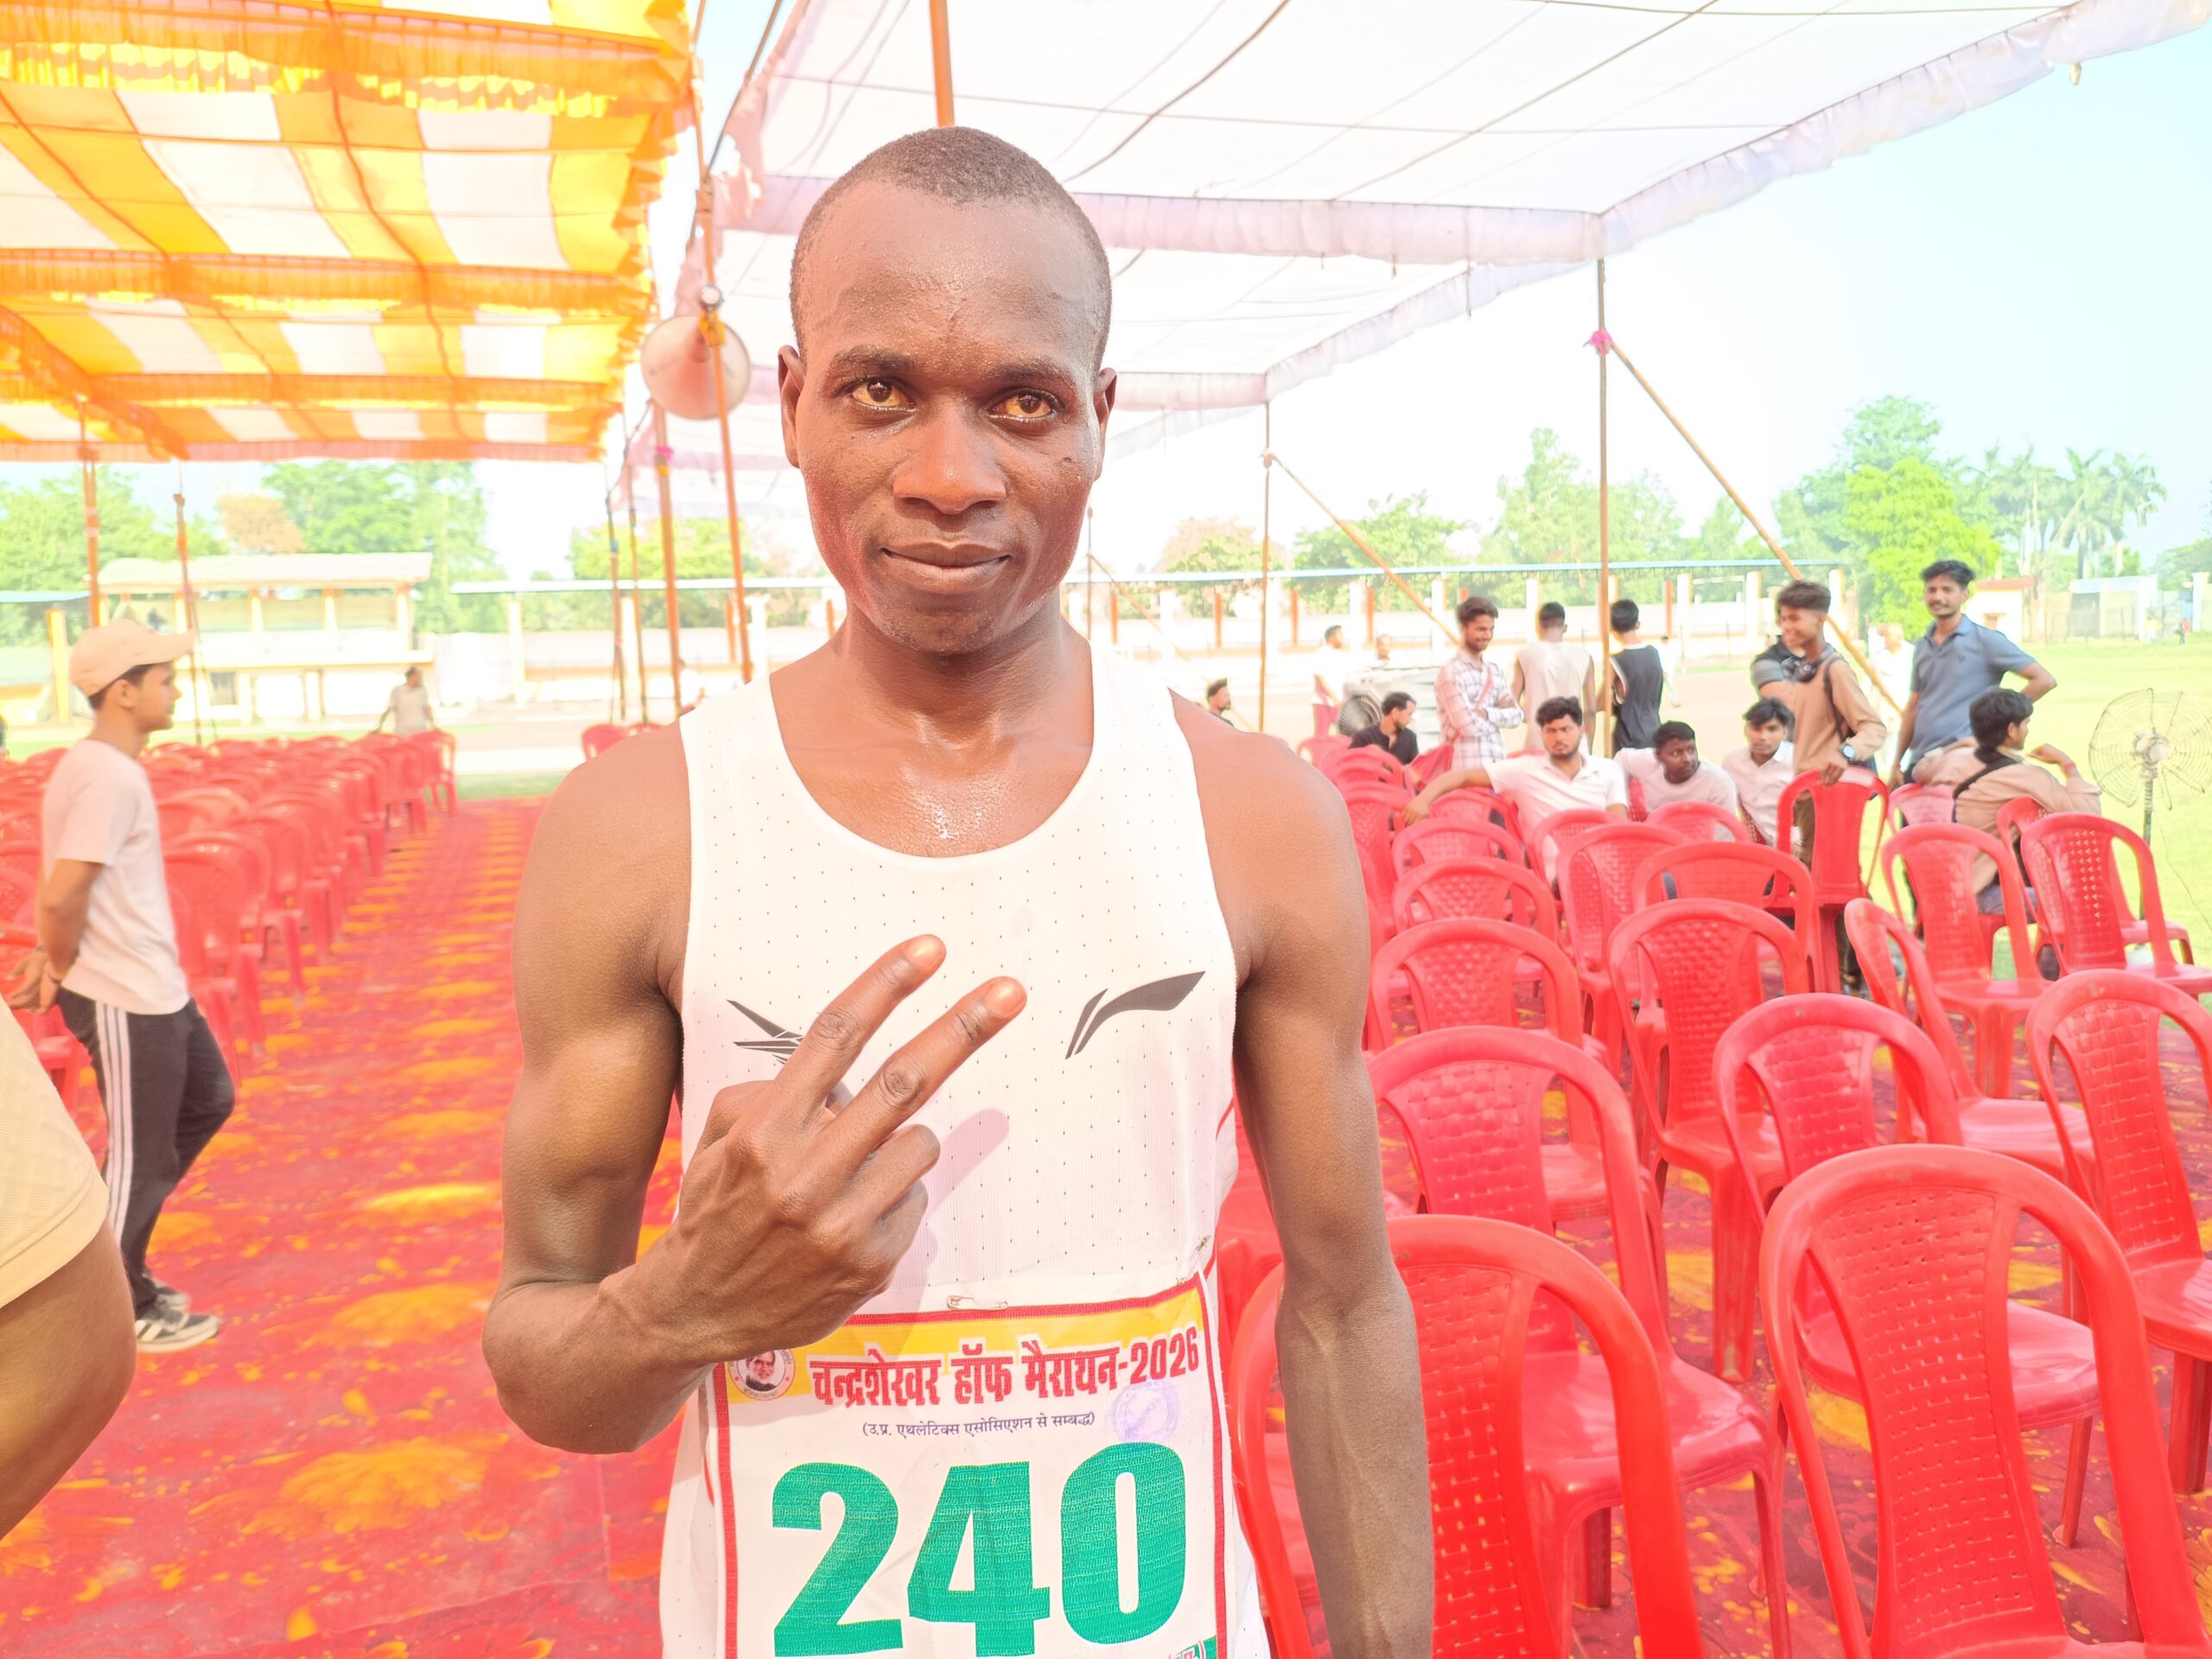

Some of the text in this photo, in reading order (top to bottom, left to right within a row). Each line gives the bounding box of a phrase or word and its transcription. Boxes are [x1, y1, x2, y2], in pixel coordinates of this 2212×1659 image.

[809, 1348, 942, 1408] चन्द्रशेखर
[950, 1343, 1014, 1404] हॉफ
[895, 1420, 960, 1440] एथलेटिक्स
[963, 1416, 1033, 1437] एसोसिएशन
[1036, 1412, 1048, 1427] से
[1051, 1410, 1096, 1427] सम्बद्ध)
[772, 1442, 1186, 1658] 240
